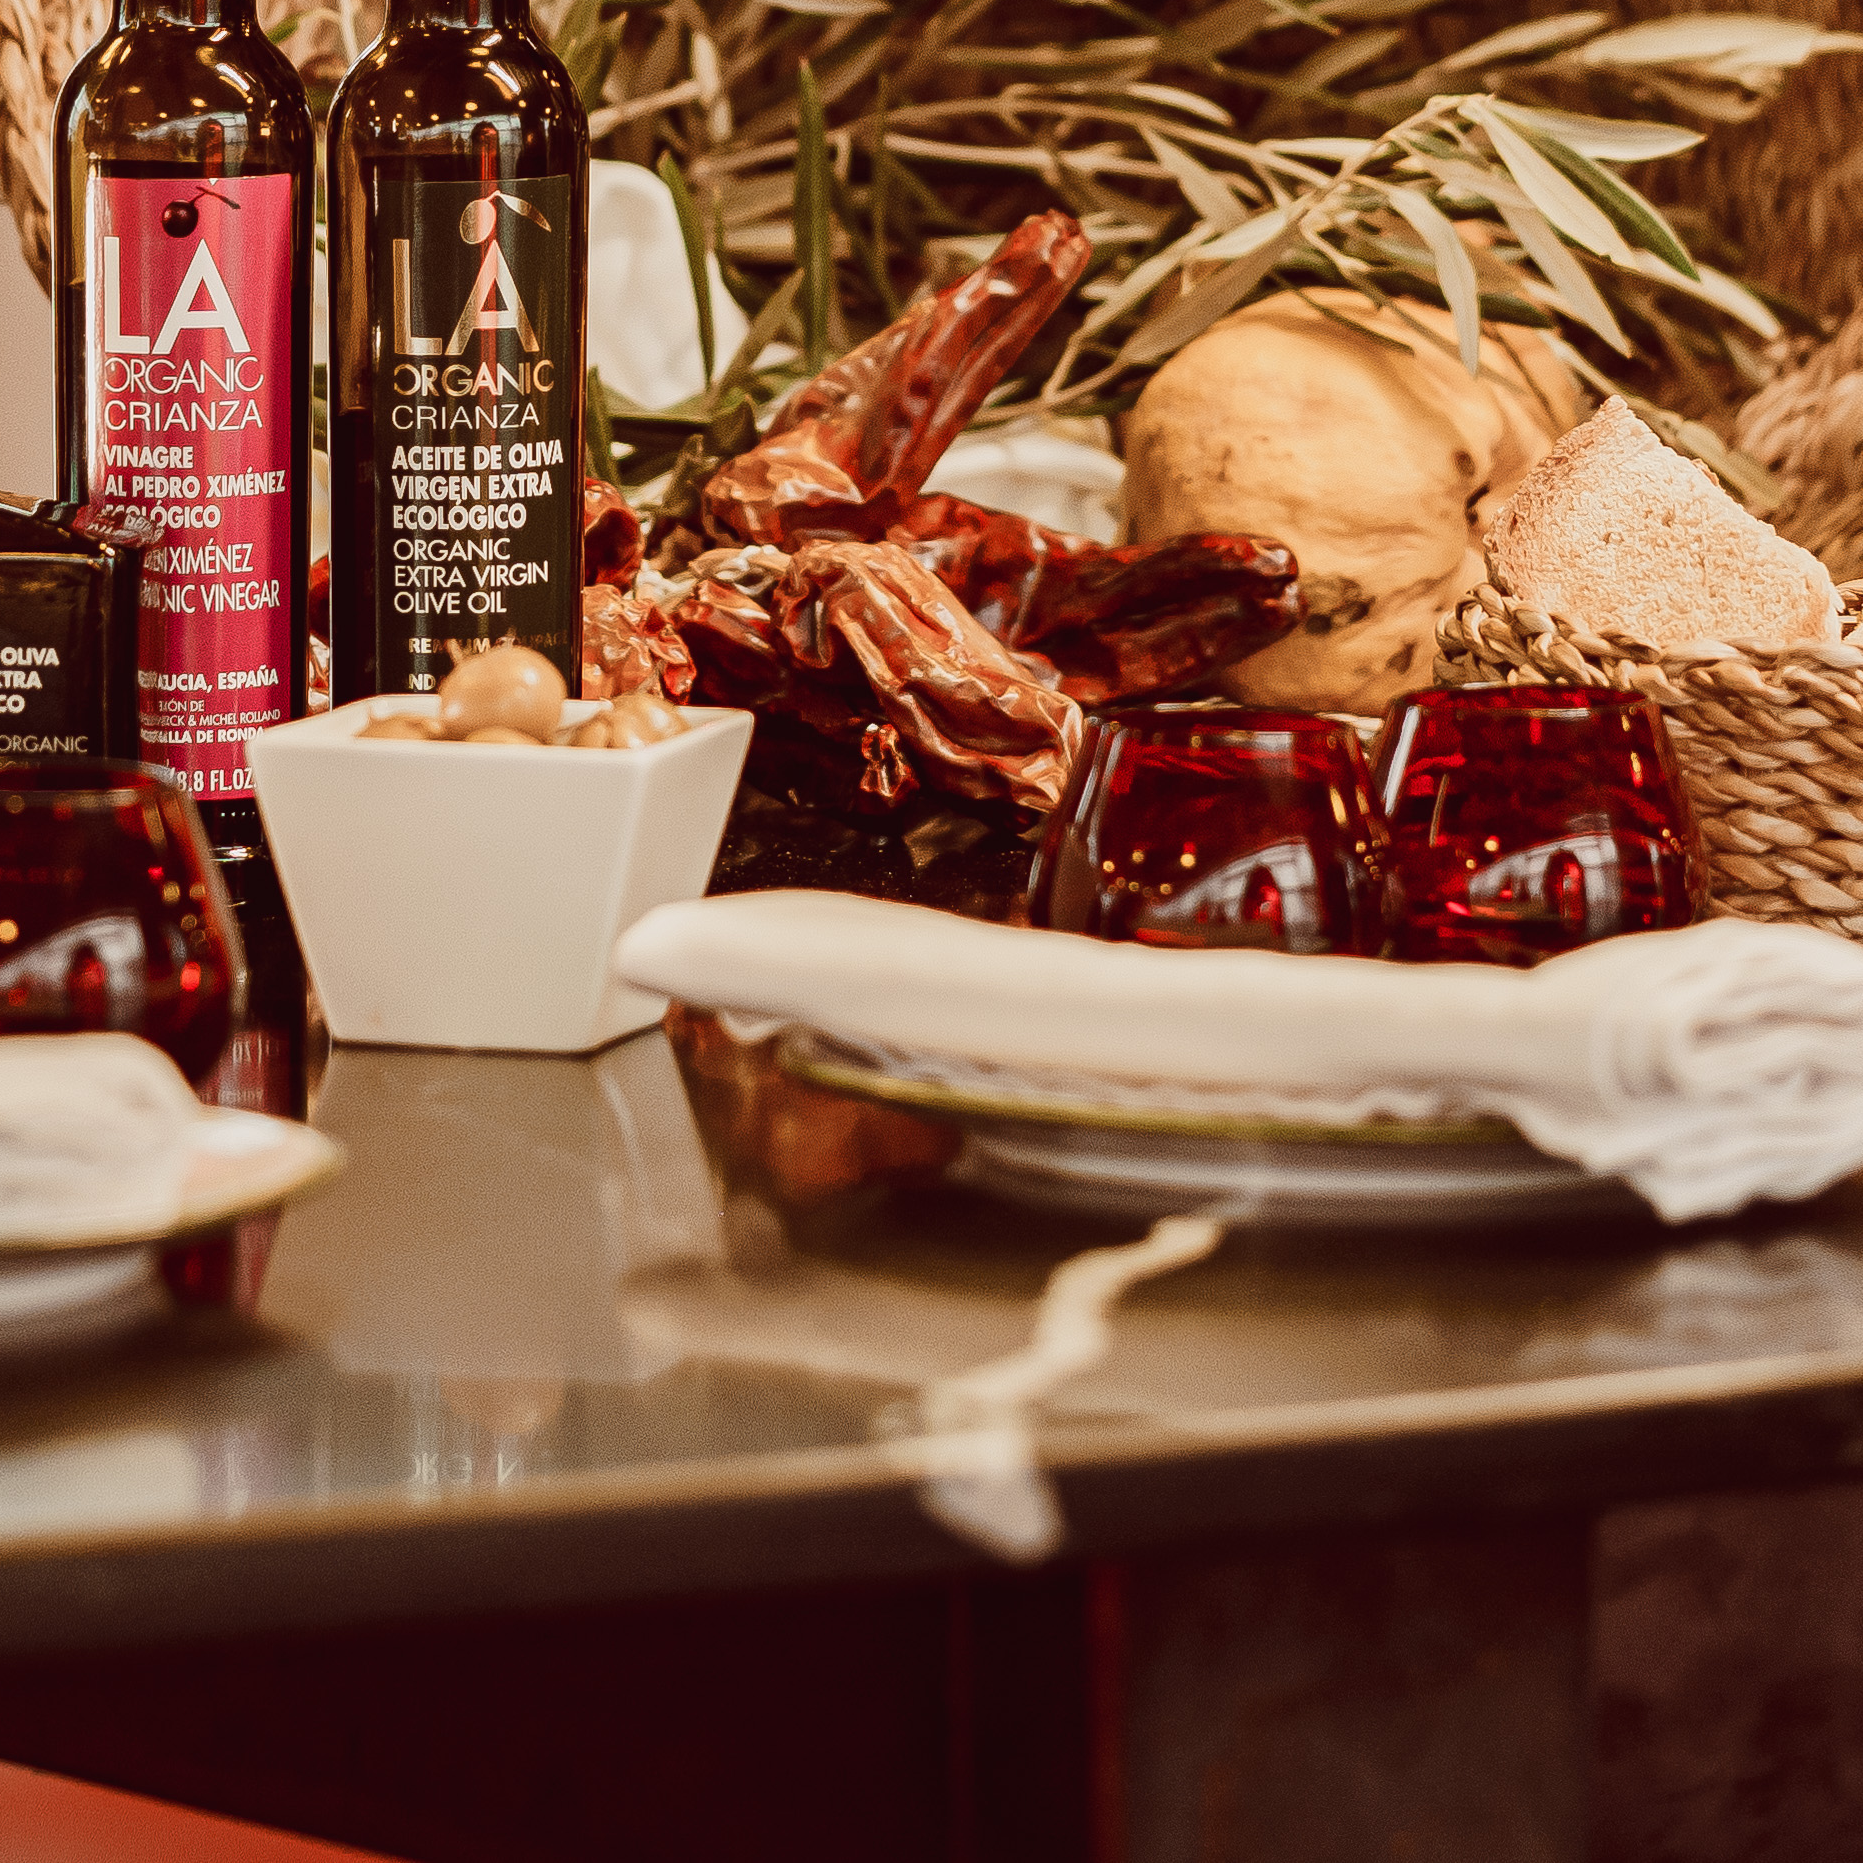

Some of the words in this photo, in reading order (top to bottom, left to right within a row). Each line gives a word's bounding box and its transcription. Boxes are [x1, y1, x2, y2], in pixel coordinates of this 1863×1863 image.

[104, 236, 251, 355] LA
[393, 238, 540, 356] LA
[105, 356, 264, 394] ORGANIC
[394, 359, 555, 397] ORGANIC
[105, 399, 263, 432] CRIANZA
[392, 403, 540, 431] CRIANZA
[103, 444, 194, 469] VINAGRE
[392, 444, 466, 471] ACEITE
[473, 444, 502, 471] DE
[509, 439, 564, 469] OLIVA
[105, 474, 126, 497] AL
[132, 475, 200, 499] PEDRO
[206, 466, 286, 498] XIMÉNEZ
[392, 474, 480, 501] VIRGEN
[488, 471, 553, 500] EXTRA
[393, 497, 527, 531] ECOLÓGICO
[169, 538, 254, 575] XIMÉNEZ
[393, 538, 511, 562] ORGANIC
[394, 565, 466, 588] EXTRA
[472, 561, 549, 587] VIRGIN
[200, 579, 280, 614] VINEGAR
[393, 592, 460, 615] OLIVE
[468, 590, 507, 614] OIL
[0, 647, 60, 667] OLIVA
[217, 665, 279, 691] ESPAÑA
[188, 714, 197, 726] &
[198, 712, 238, 726] MICHEL
[239, 709, 281, 724] ROLLAND
[190, 700, 205, 712] DE
[196, 729, 214, 743] DE
